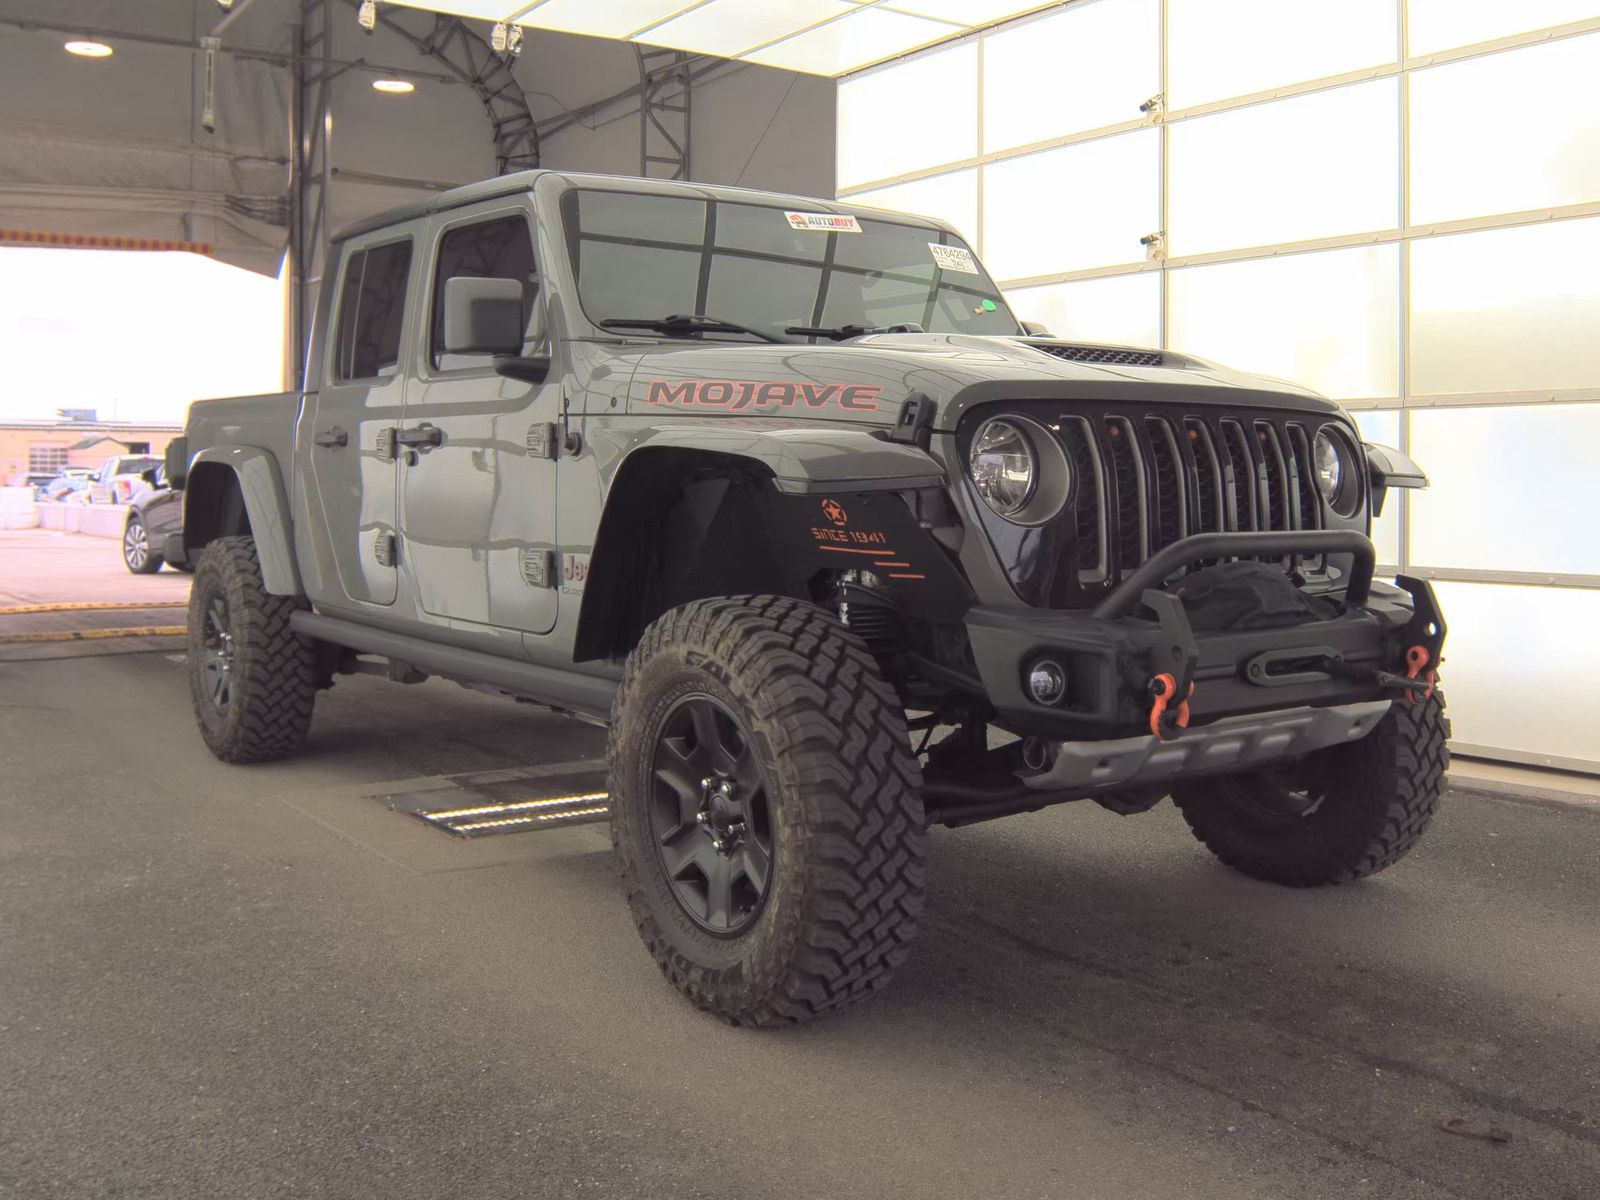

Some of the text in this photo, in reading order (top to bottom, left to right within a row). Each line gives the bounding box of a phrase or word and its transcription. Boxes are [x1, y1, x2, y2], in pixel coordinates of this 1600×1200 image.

[807, 215, 854, 227] AUTOBUY
[648, 380, 884, 411] MOJAVE
[810, 527, 886, 543] SINCE 1941
[564, 554, 589, 582] Je
